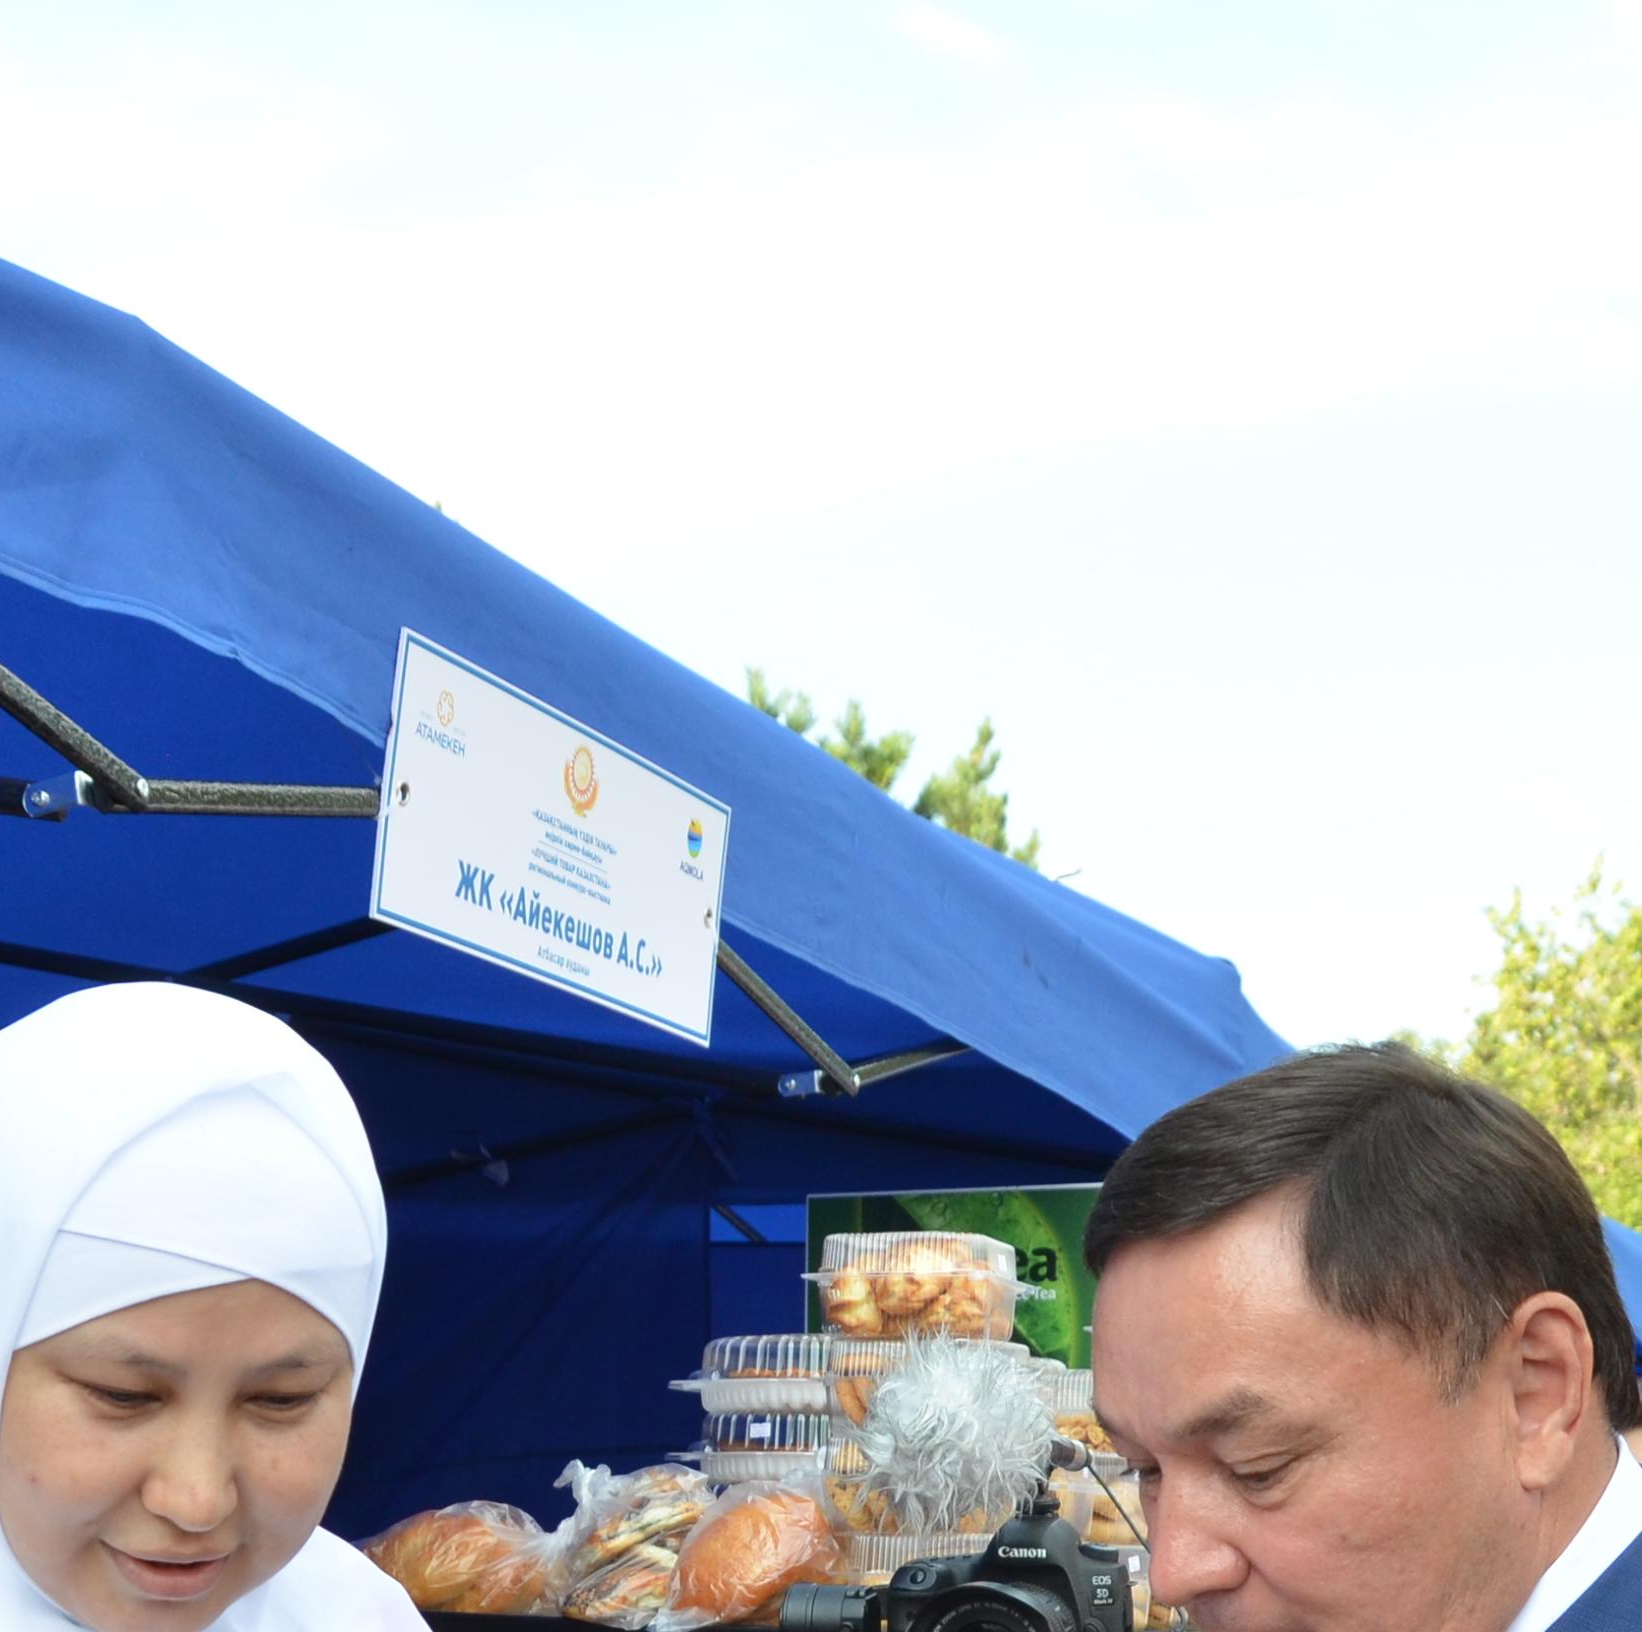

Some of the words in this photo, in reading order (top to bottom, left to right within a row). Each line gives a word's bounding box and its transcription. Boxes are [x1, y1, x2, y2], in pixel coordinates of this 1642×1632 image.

[415, 721, 466, 758] АТАМЕКЕН
[455, 859, 495, 911] ЖК
[500, 886, 614, 960] «Айекешов
[616, 931, 663, 978] А.С.»
[997, 1546, 1047, 1558] Canon
[1092, 1575, 1112, 1585] EOS
[1096, 1588, 1109, 1598] 5D
